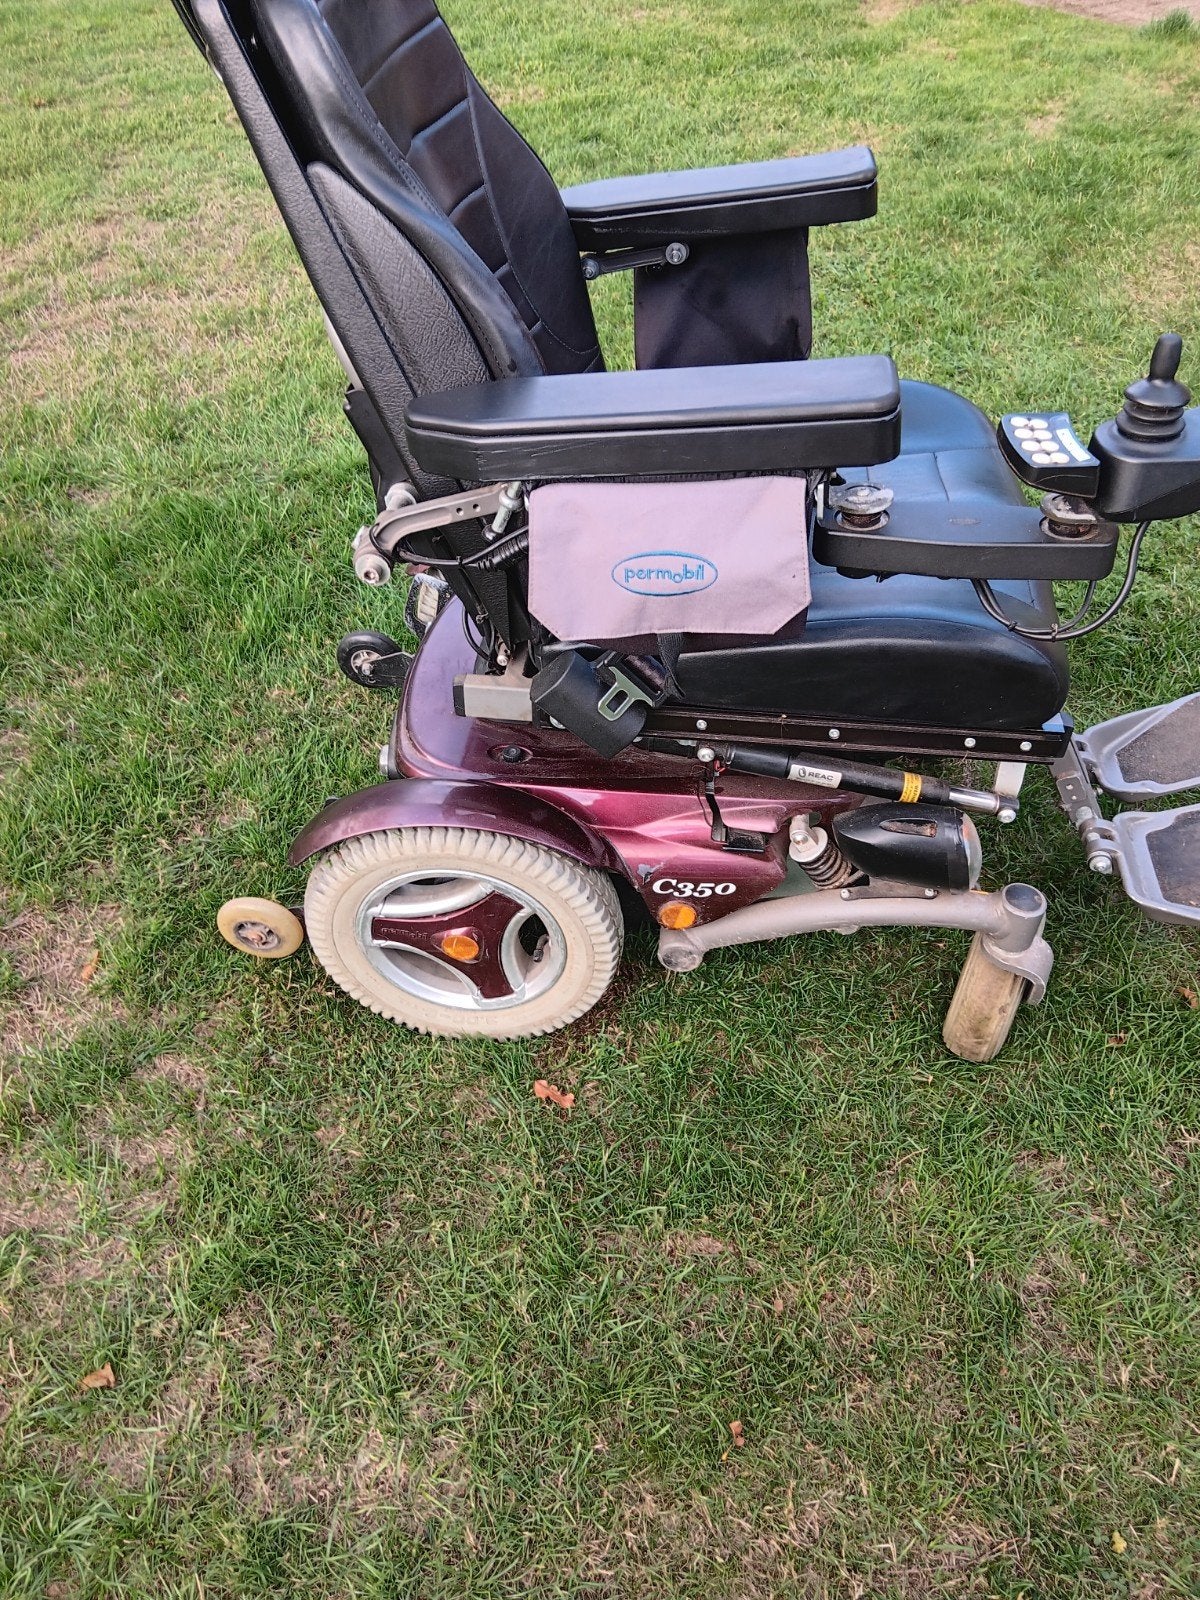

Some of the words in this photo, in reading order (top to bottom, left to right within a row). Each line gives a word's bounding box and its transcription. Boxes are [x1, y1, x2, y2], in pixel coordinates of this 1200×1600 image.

[624, 563, 704, 583] permobil
[807, 771, 834, 782] REAC
[652, 878, 737, 898] C350
